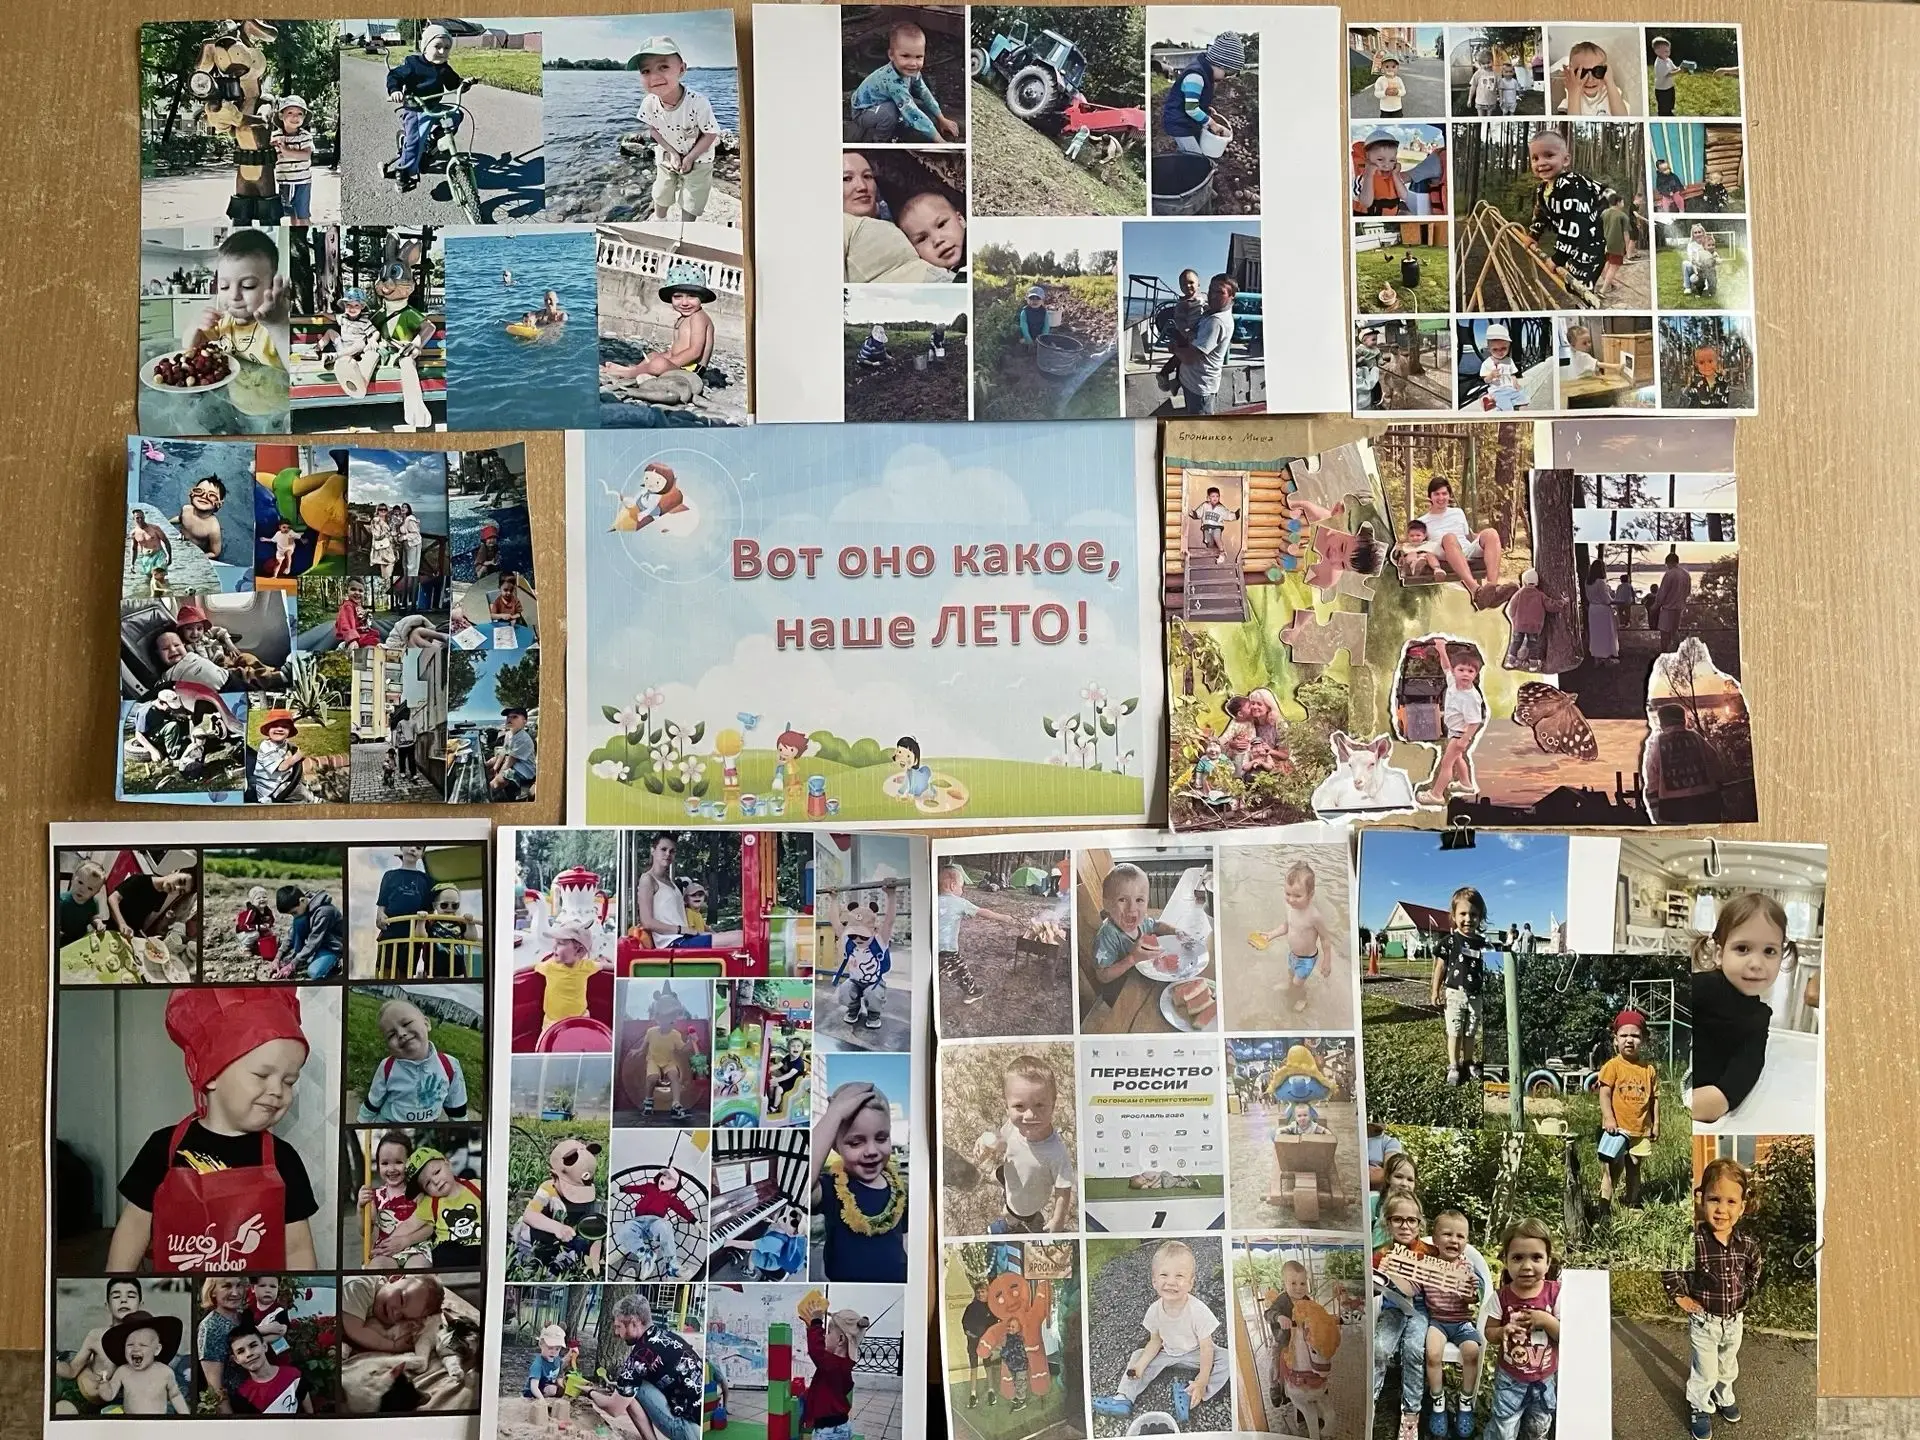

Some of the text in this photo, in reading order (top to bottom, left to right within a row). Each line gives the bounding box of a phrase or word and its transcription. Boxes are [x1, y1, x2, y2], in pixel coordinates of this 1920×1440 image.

[1179, 431, 1274, 443] Бронников Миша
[732, 538, 1121, 580] Вот оно какое,
[775, 600, 1089, 650] наше ЛЕТО!
[1090, 1066, 1213, 1078] ПЕРВЕНСТВО
[1112, 1080, 1188, 1091] РОССИИ
[406, 1109, 433, 1122] OUR
[1151, 1211, 1167, 1229] 1
